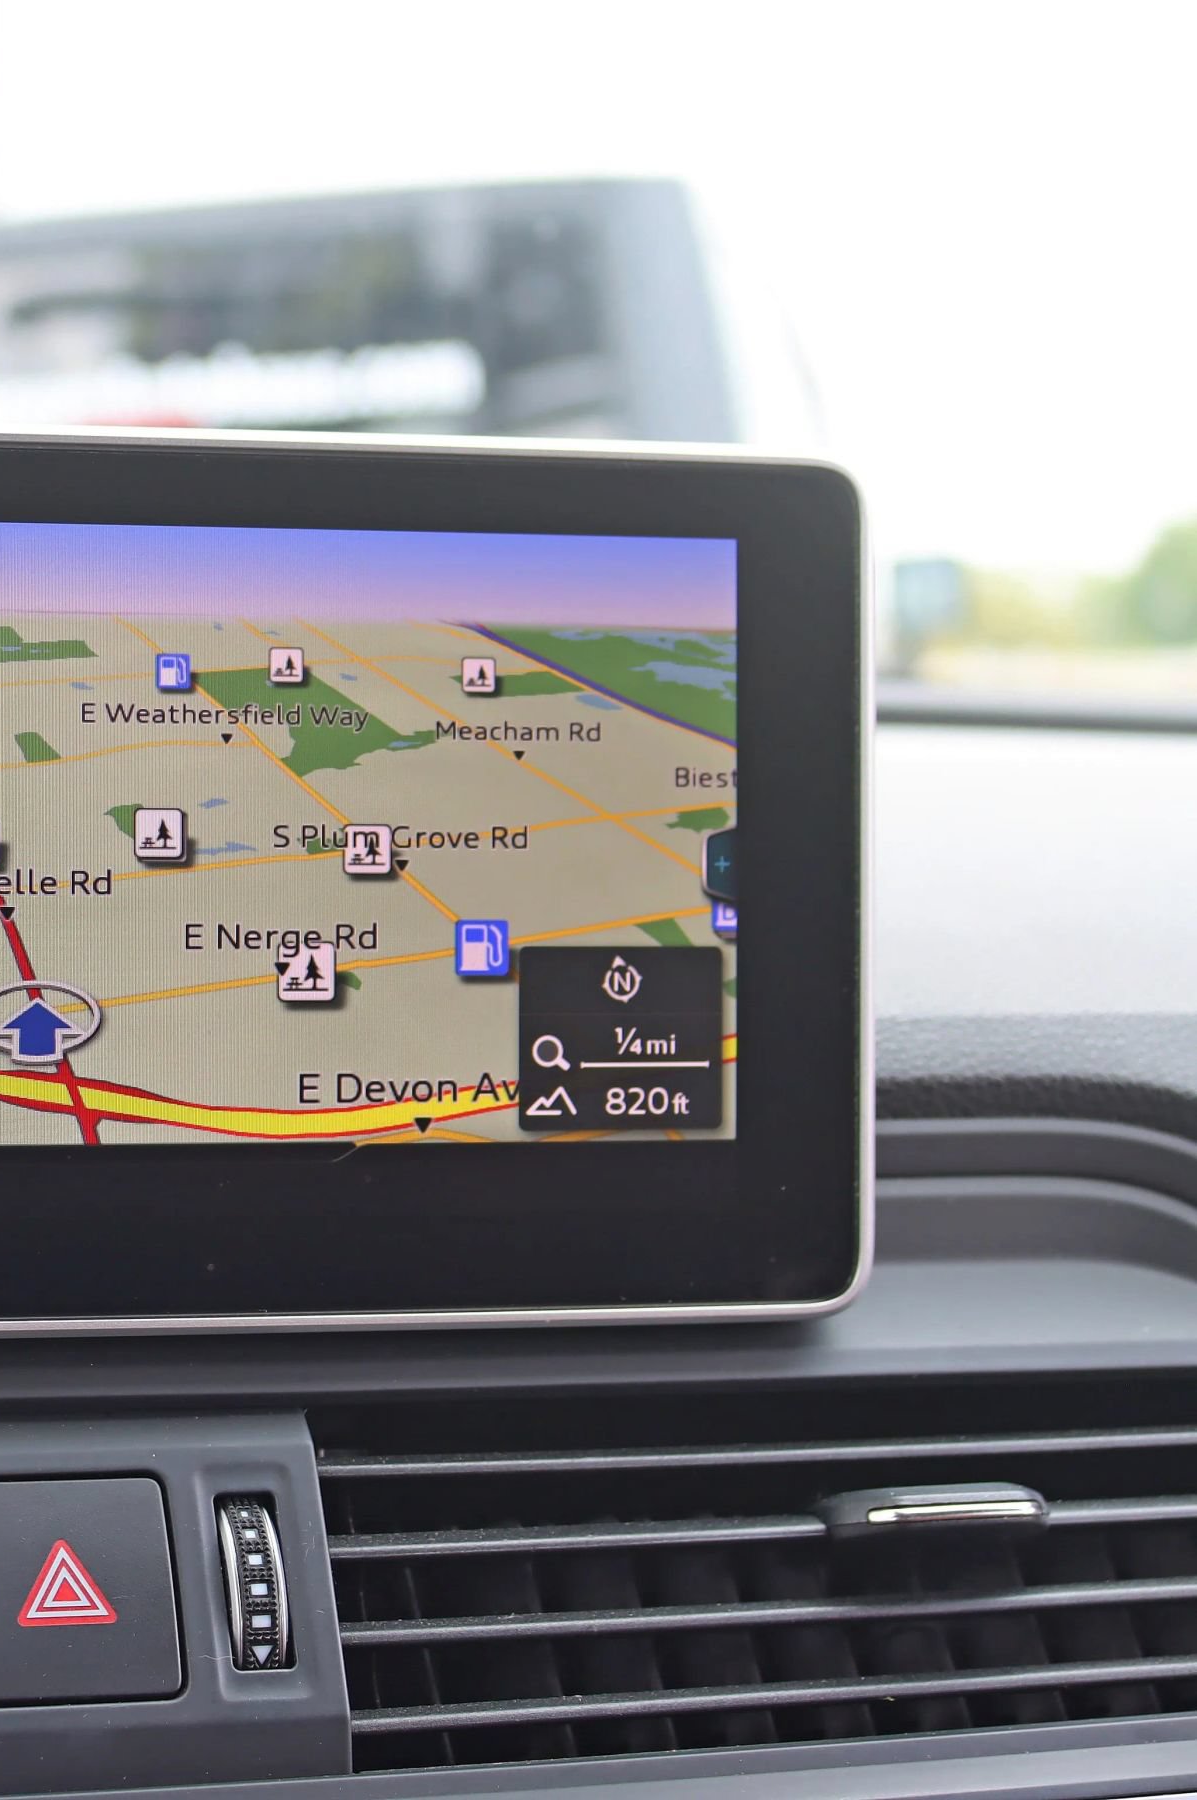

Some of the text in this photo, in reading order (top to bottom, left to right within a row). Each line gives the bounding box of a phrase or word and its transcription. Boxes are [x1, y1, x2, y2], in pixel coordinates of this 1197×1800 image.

[82, 703, 369, 732] E Weathersfield Way
[435, 721, 601, 743] Meacham Rd
[273, 825, 529, 850] S Plum Grove Rd
[71, 870, 112, 895] Rd
[185, 923, 379, 956] E Nerge Rd
[300, 1073, 520, 1104] E Devon Av
